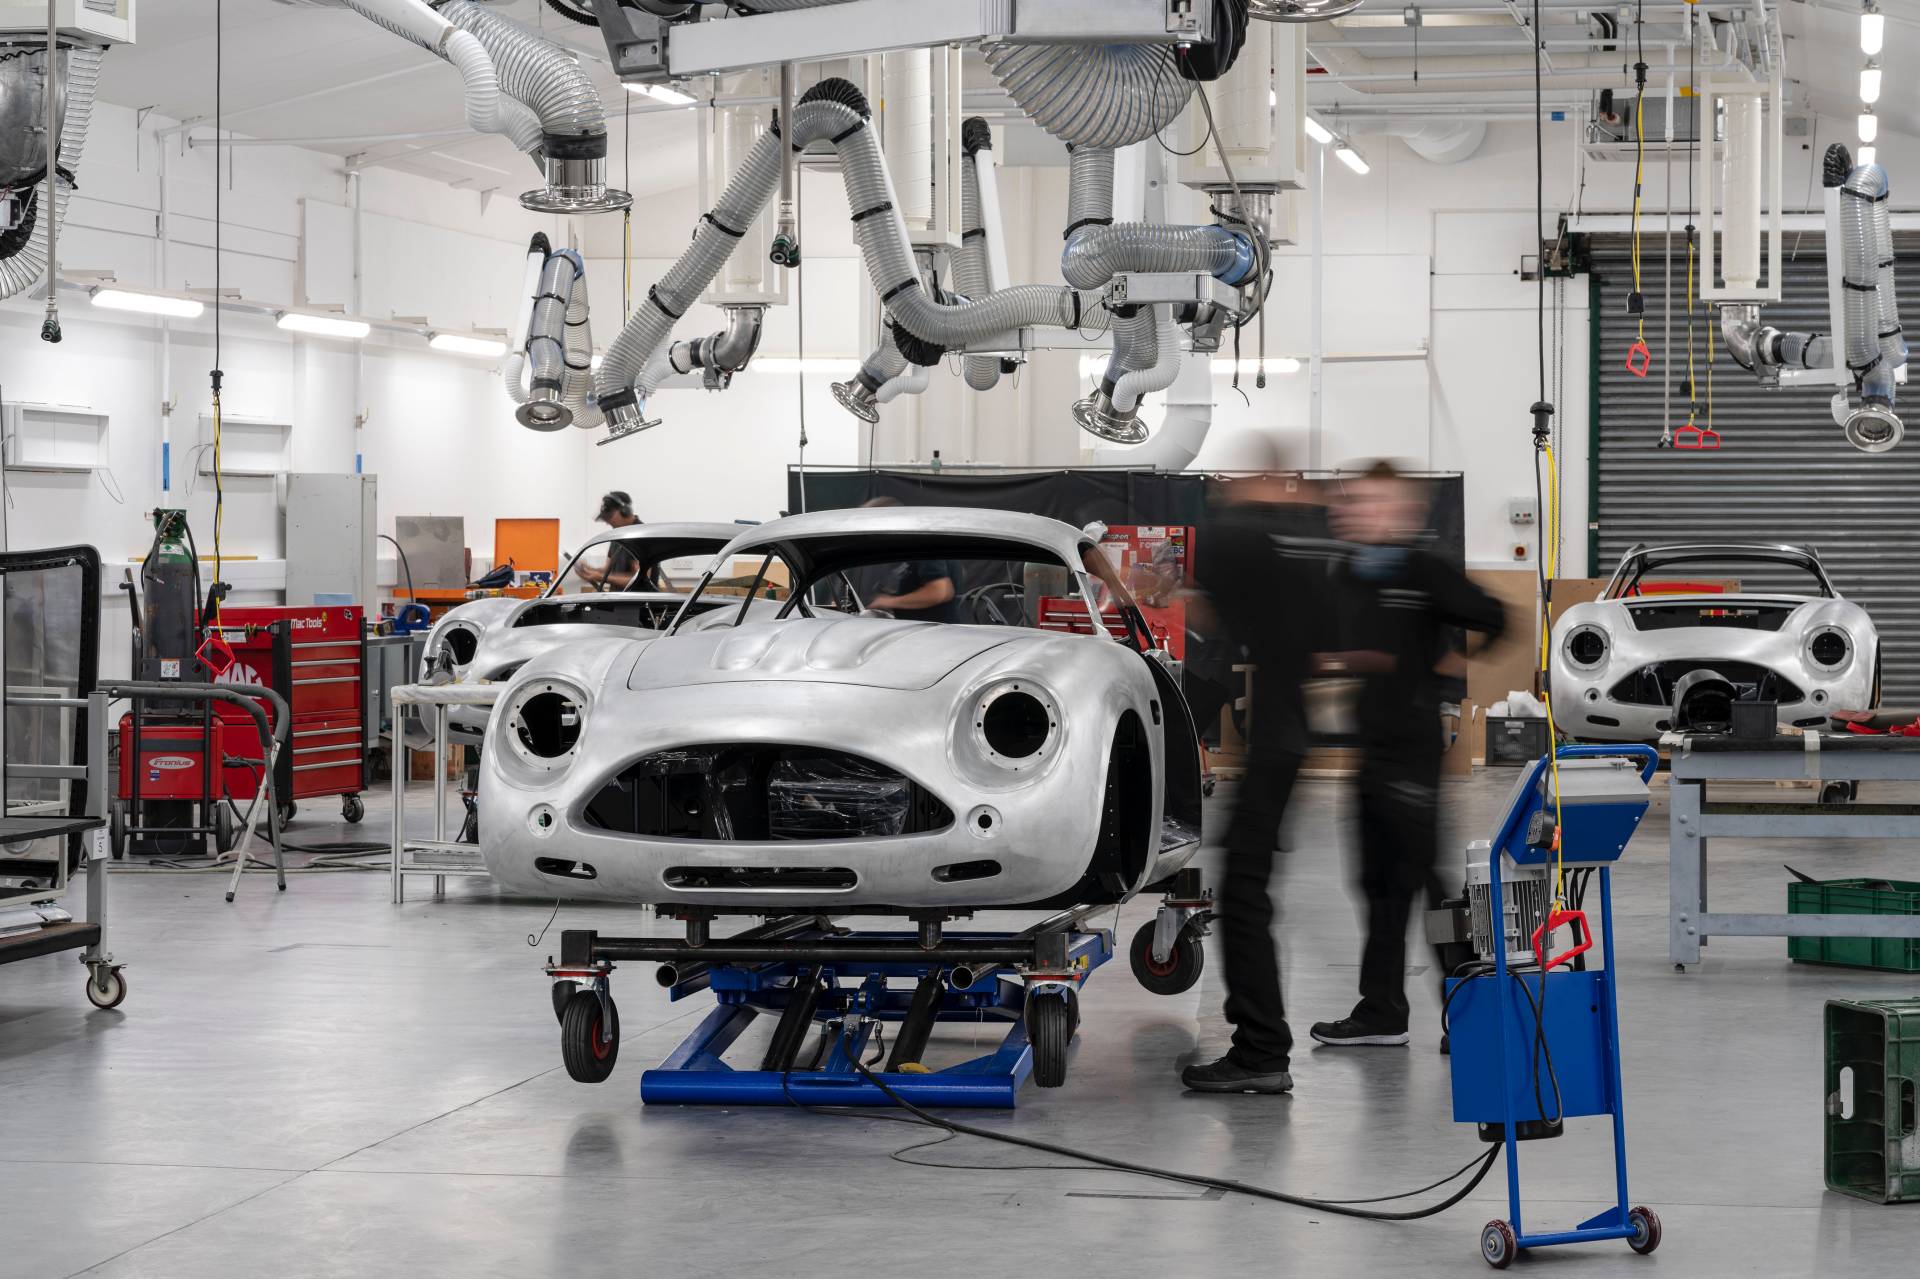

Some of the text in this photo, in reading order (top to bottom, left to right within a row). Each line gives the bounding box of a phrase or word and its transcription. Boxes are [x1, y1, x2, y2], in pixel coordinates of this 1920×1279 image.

[291, 617, 322, 630] Mac Tools
[153, 758, 192, 766] Fronius
